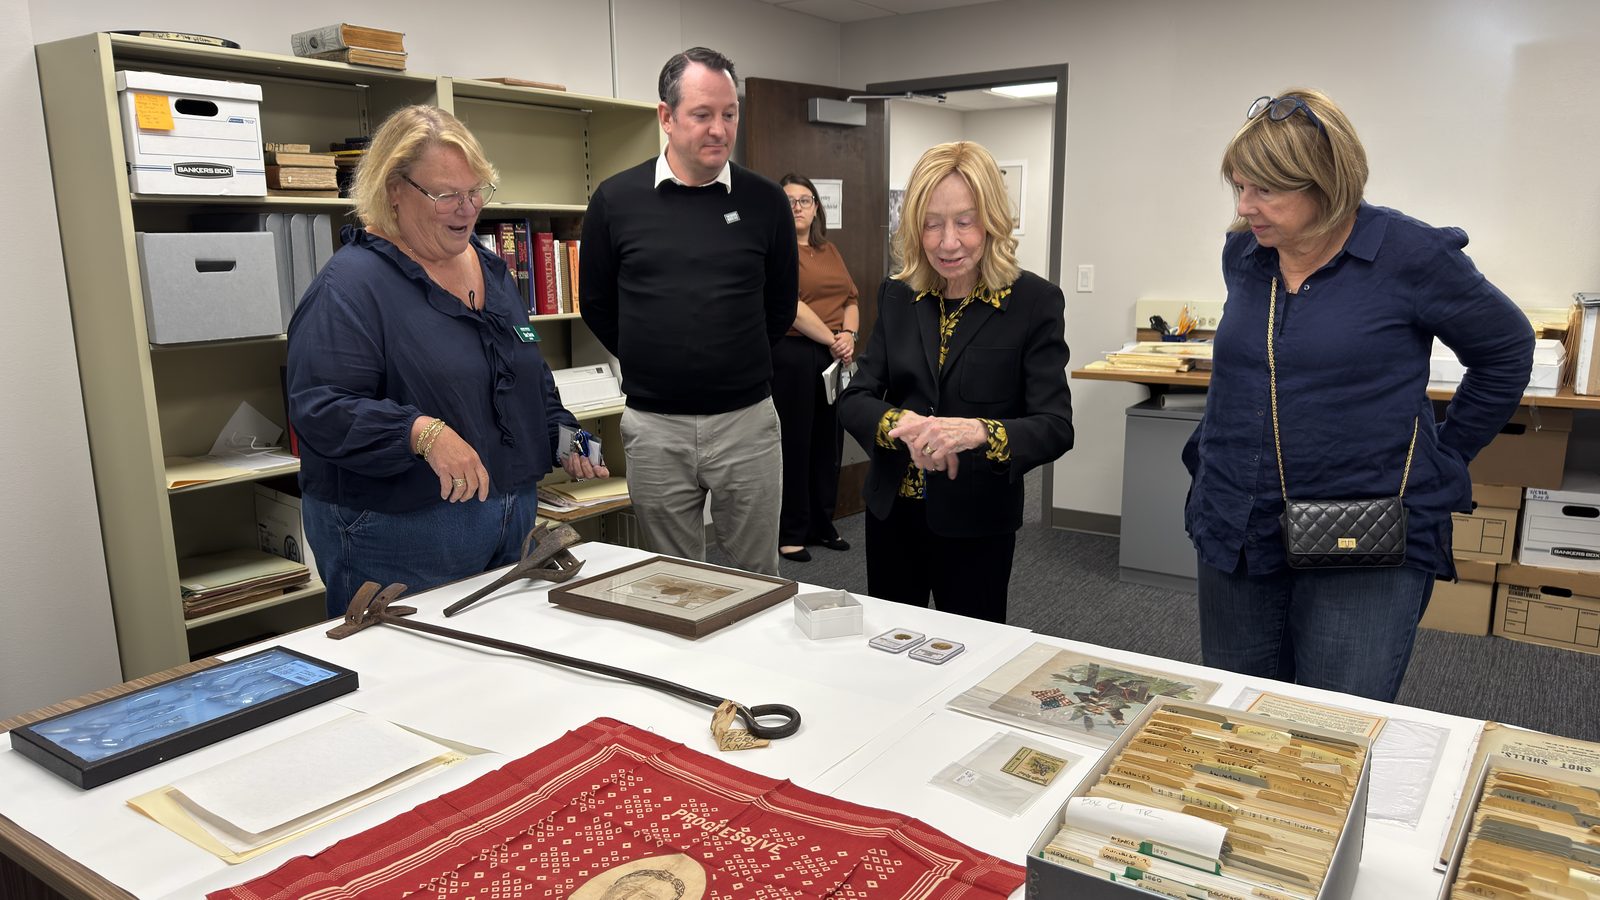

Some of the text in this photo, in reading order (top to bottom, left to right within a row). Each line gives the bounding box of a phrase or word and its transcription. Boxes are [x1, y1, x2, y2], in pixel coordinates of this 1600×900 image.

[177, 166, 214, 174] BANKERS
[544, 252, 555, 304] DICTIONARY
[1554, 549, 1586, 557] BANKERS
[1560, 762, 1592, 773] SHOT
[671, 808, 788, 855] PROGRESSIVE
